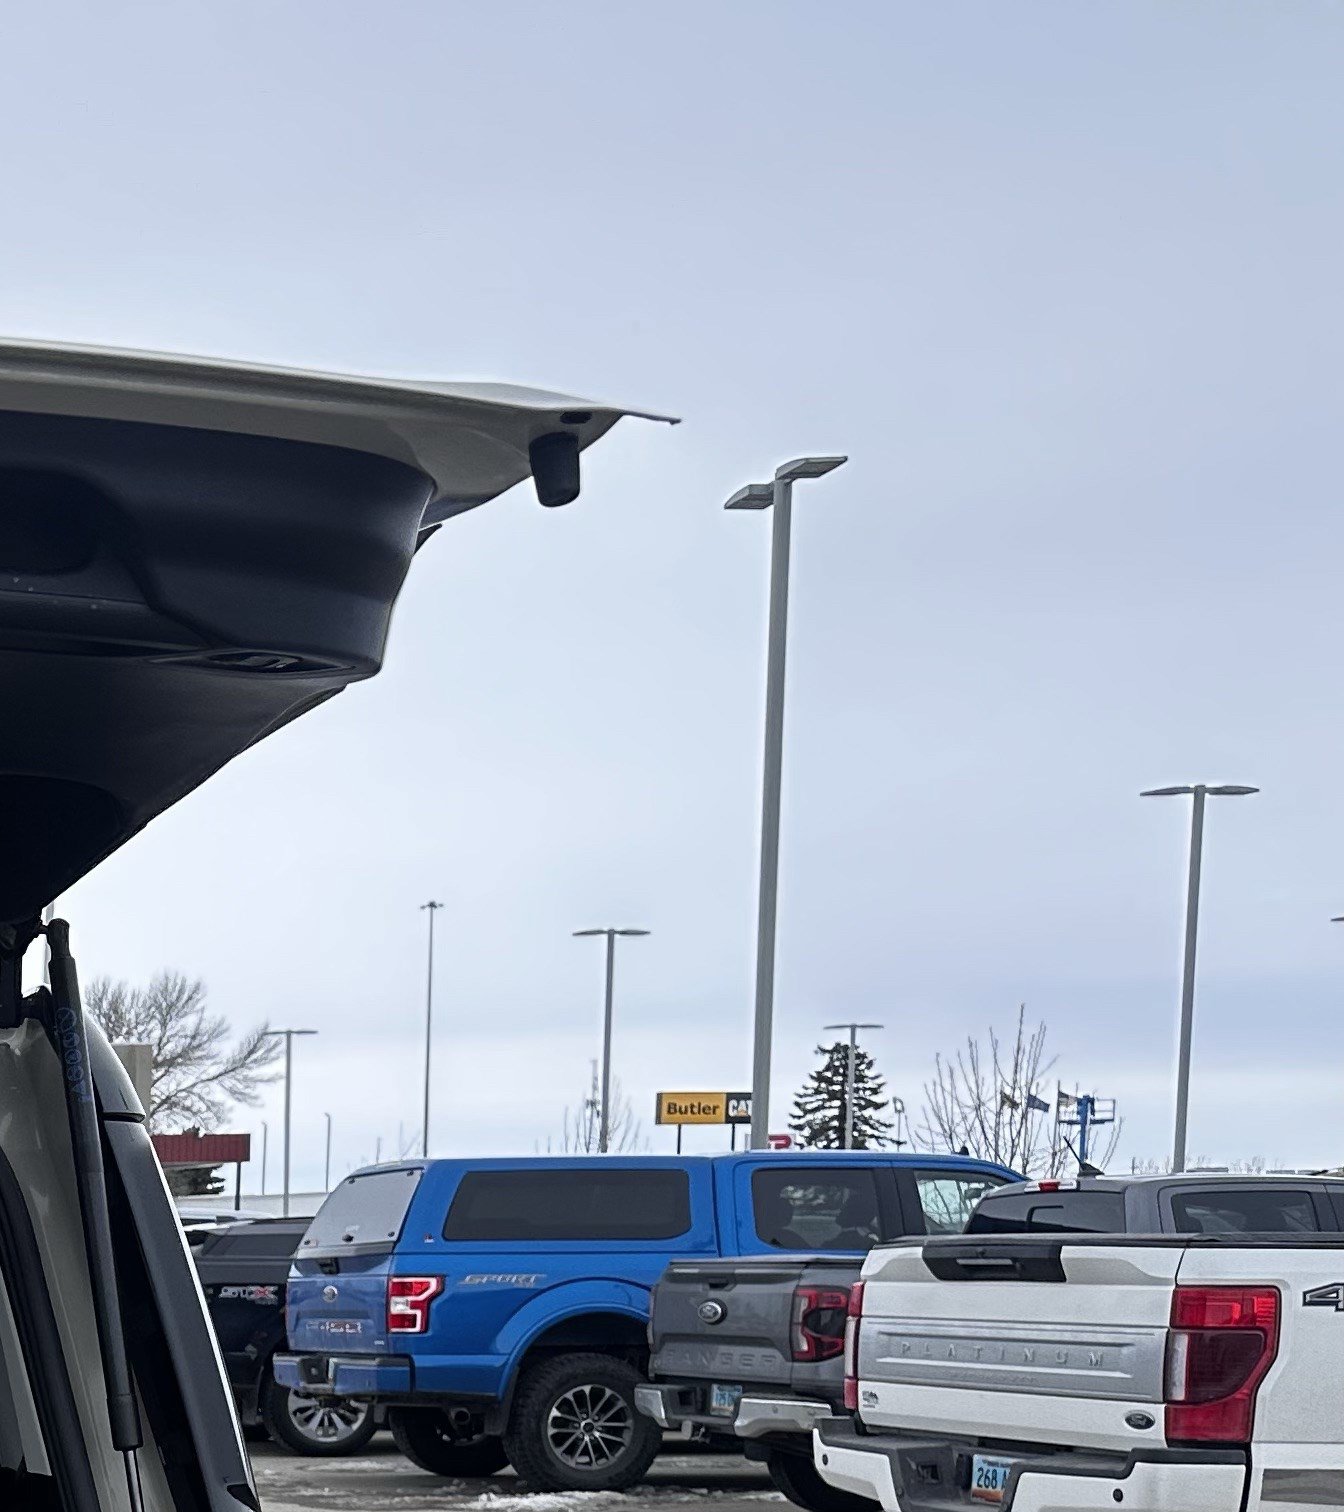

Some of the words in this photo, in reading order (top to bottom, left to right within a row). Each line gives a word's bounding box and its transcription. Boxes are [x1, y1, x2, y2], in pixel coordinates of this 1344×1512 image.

[666, 1101, 720, 1116] Butler
[666, 1349, 778, 1368] RANGER
[900, 1341, 1105, 1367] PLATINUM
